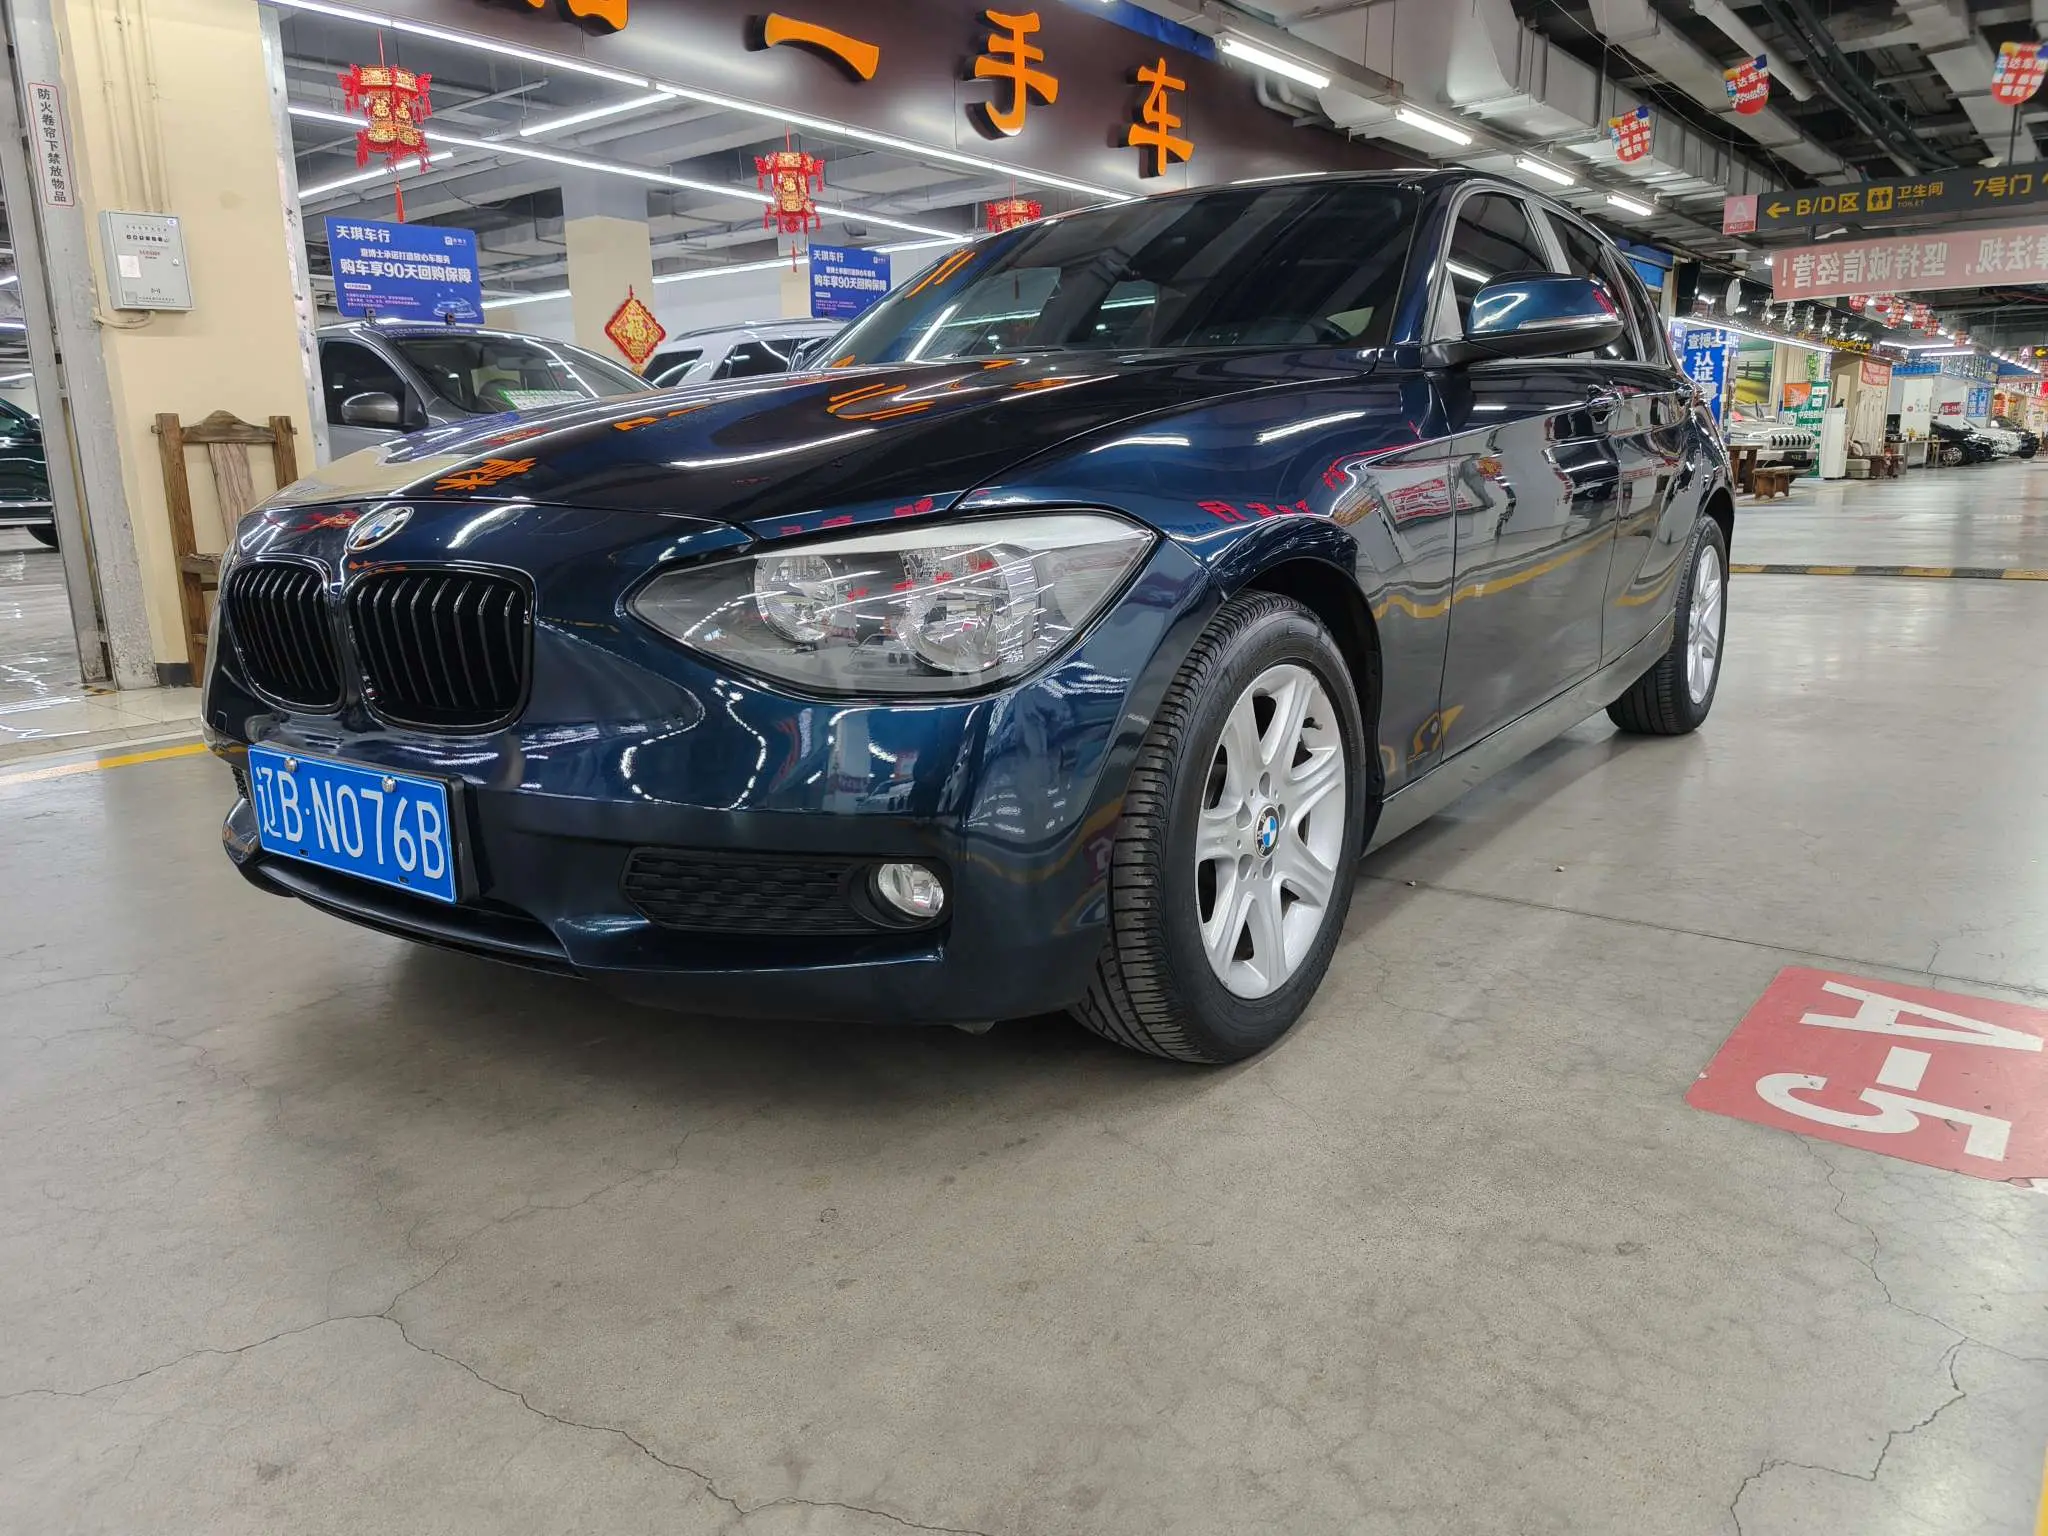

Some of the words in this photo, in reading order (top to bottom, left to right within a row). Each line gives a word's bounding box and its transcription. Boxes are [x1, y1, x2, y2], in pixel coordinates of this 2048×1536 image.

[36, 87, 67, 203] 防火卷帘下禁放物品
[1896, 180, 1945, 200] 卫生间
[1972, 173, 2033, 197] 7号门
[1730, 200, 1749, 221] A
[1795, 191, 1861, 217] B/D区
[335, 224, 391, 244] 天琪车行
[340, 258, 473, 284] 购车享90天回购保障
[1755, 980, 2045, 1162] A-5
